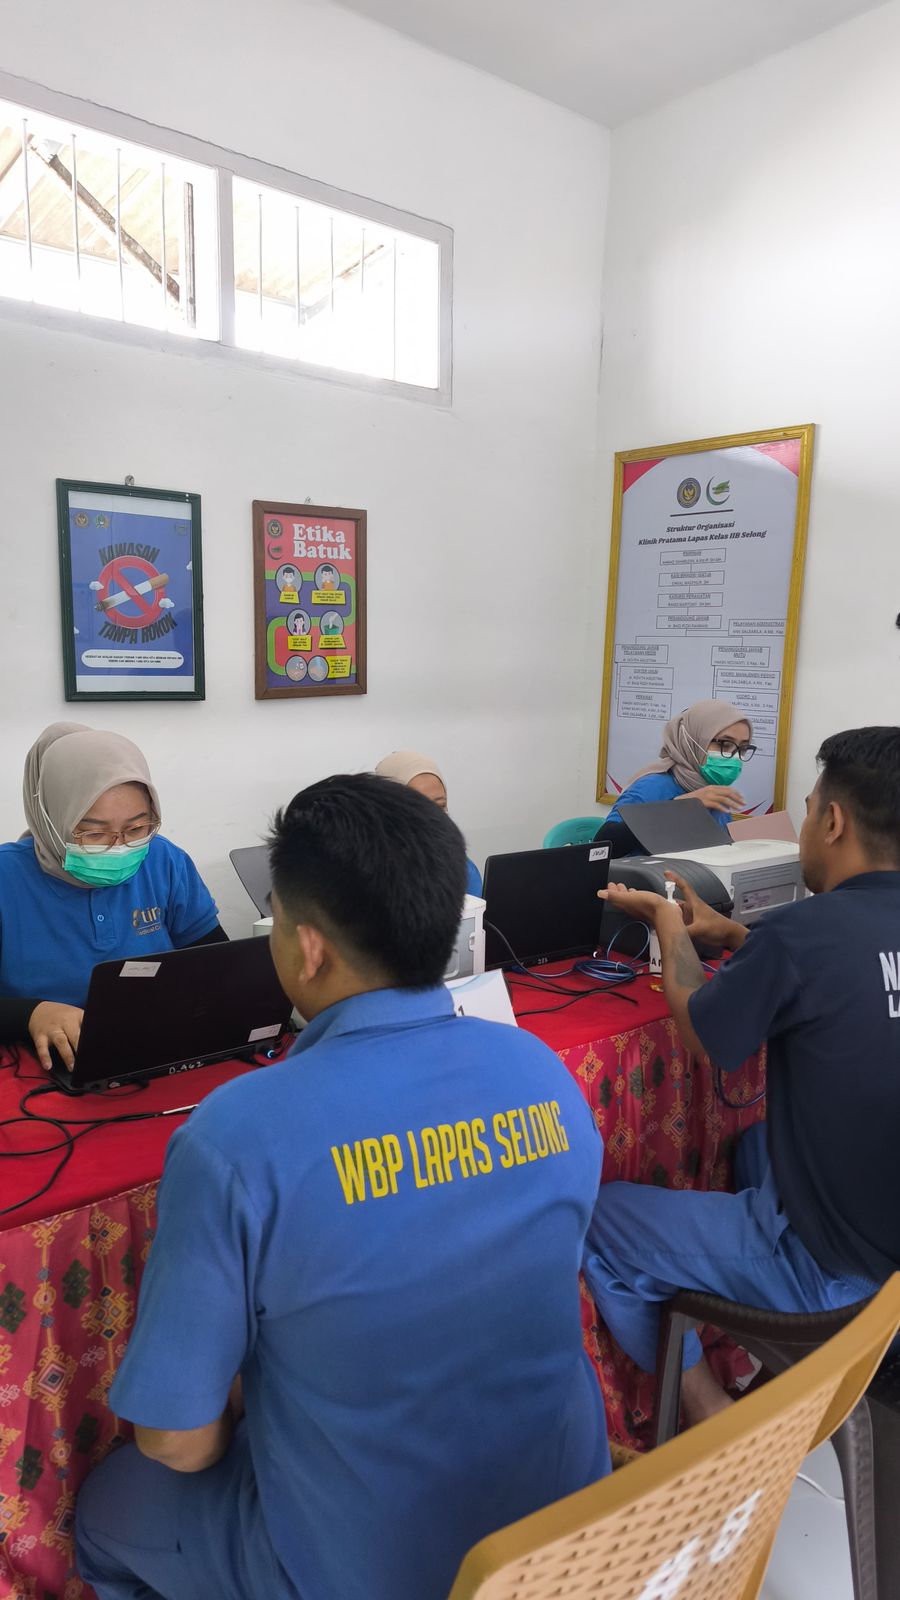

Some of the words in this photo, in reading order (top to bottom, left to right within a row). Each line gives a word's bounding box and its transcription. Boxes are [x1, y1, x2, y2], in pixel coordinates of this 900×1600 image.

[293, 523, 346, 544] Etika
[638, 538, 658, 546] Klinik
[658, 536, 687, 544] Pratama
[687, 534, 709, 543] Lapas
[709, 532, 729, 541] Kelas
[741, 530, 767, 539] Selong
[666, 525, 696, 533] Struktur
[696, 521, 736, 531] Organisasi
[99, 542, 160, 566] KAWASAN
[293, 539, 353, 561] Batuk
[98, 620, 139, 645] TANPA
[141, 611, 178, 644] ROKOK
[879, 951, 900, 992] N
[888, 994, 900, 1018] L
[331, 1133, 404, 1205] WBP
[406, 1117, 493, 1189] LAPAS
[492, 1100, 570, 1169] SELONG
